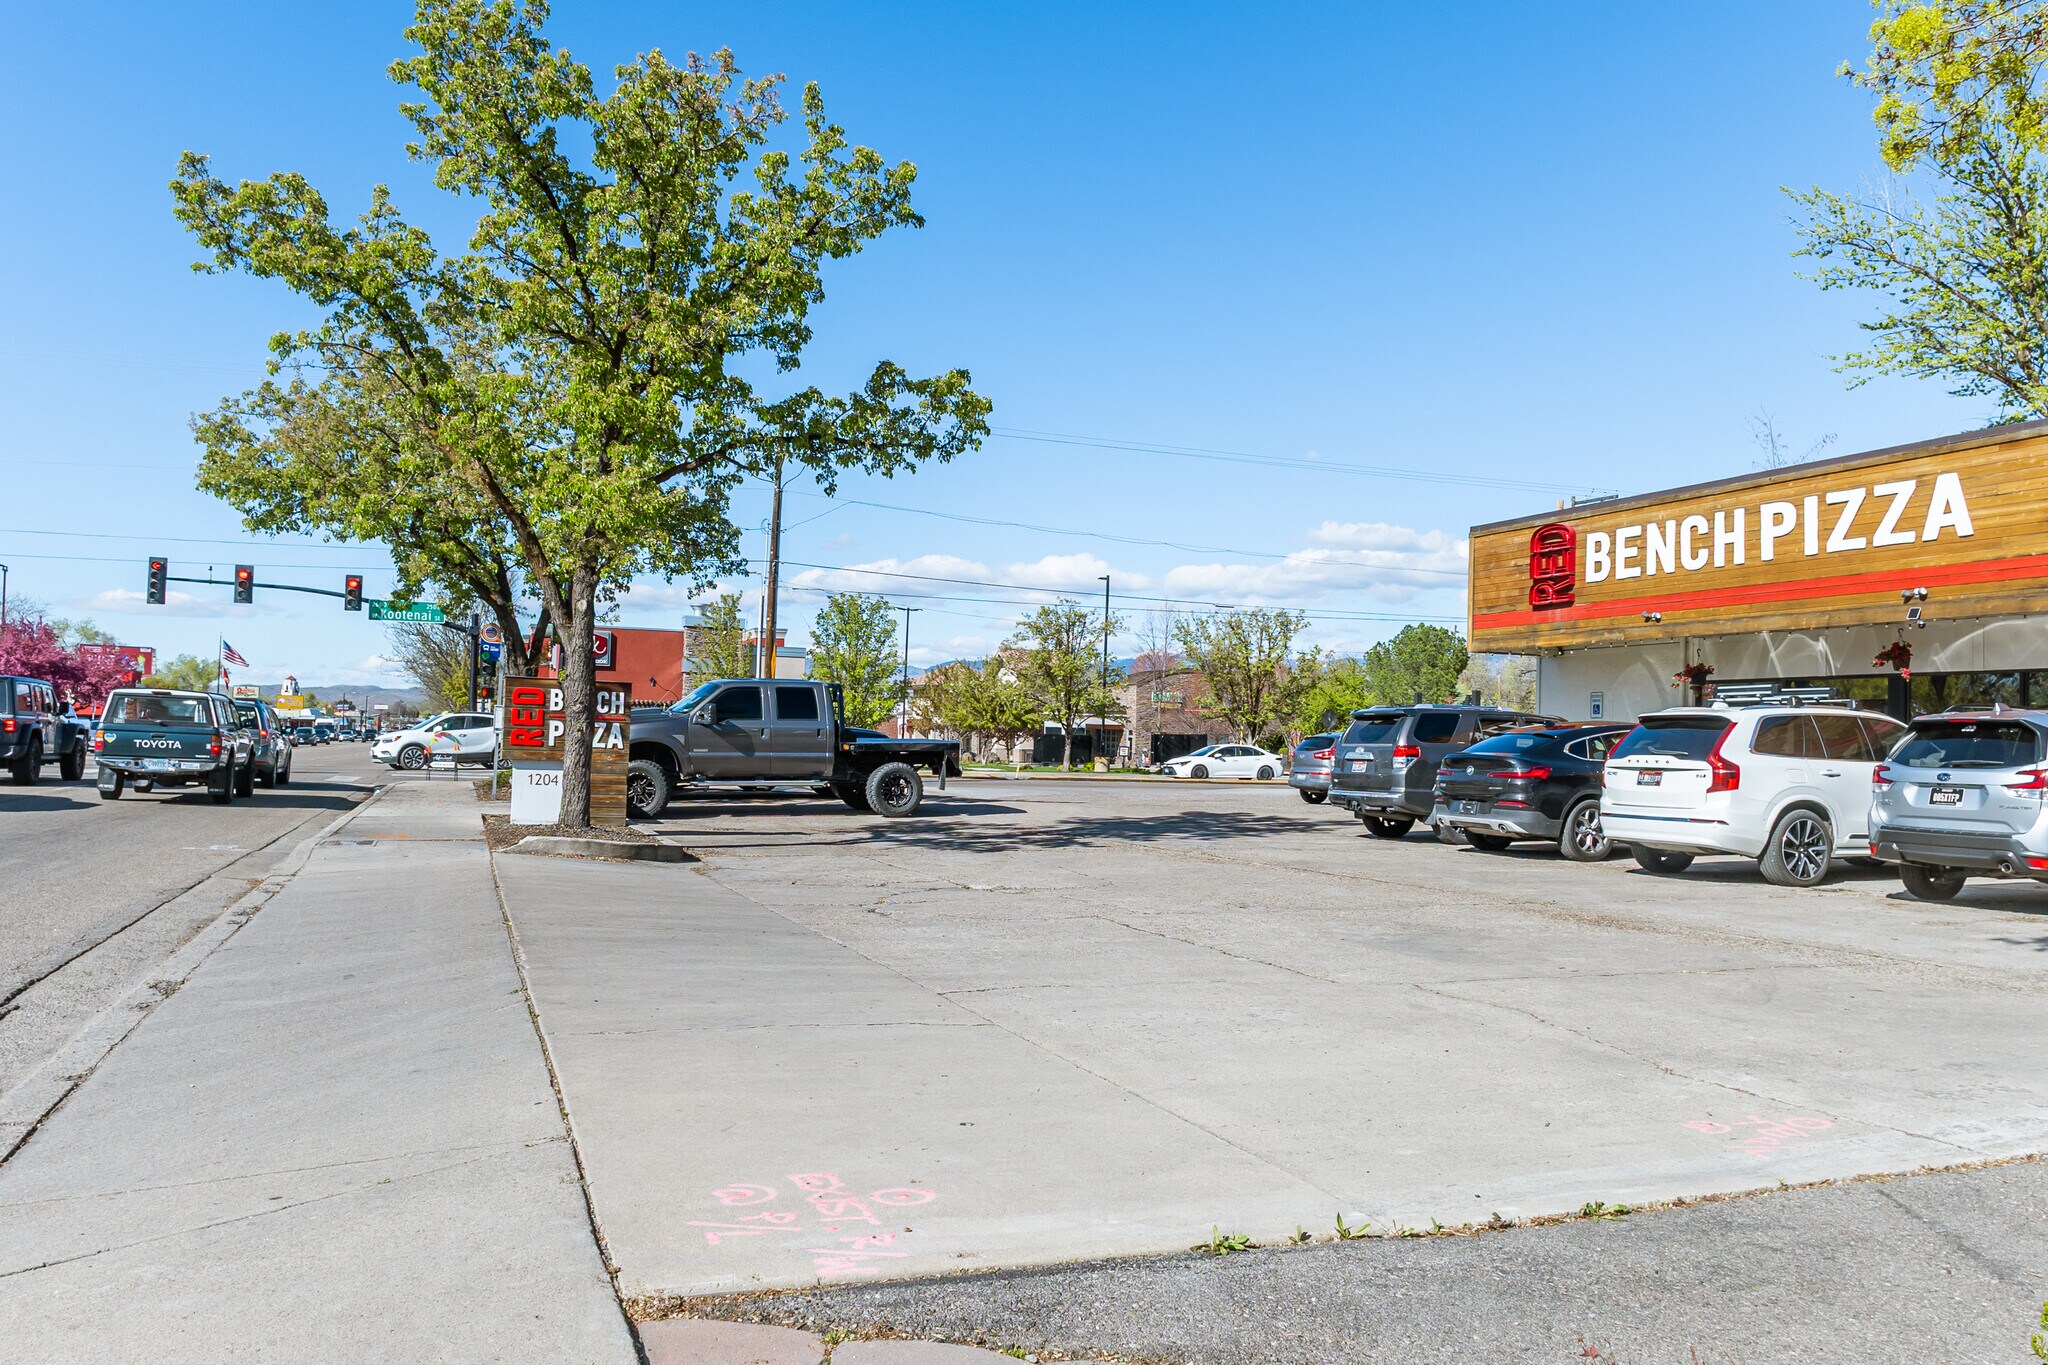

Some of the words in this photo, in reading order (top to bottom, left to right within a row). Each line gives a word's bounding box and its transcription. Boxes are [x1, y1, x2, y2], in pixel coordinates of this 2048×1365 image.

[1584, 508, 1746, 583] BENCH
[1759, 472, 1975, 562] PIZZA
[1529, 523, 1577, 608] RED
[380, 609, 432, 621] Kootenai
[549, 688, 625, 715] BCH
[509, 687, 545, 747] RED
[133, 739, 182, 749] TOYOTA
[548, 720, 624, 750] PZA
[528, 774, 559, 786] 1204
